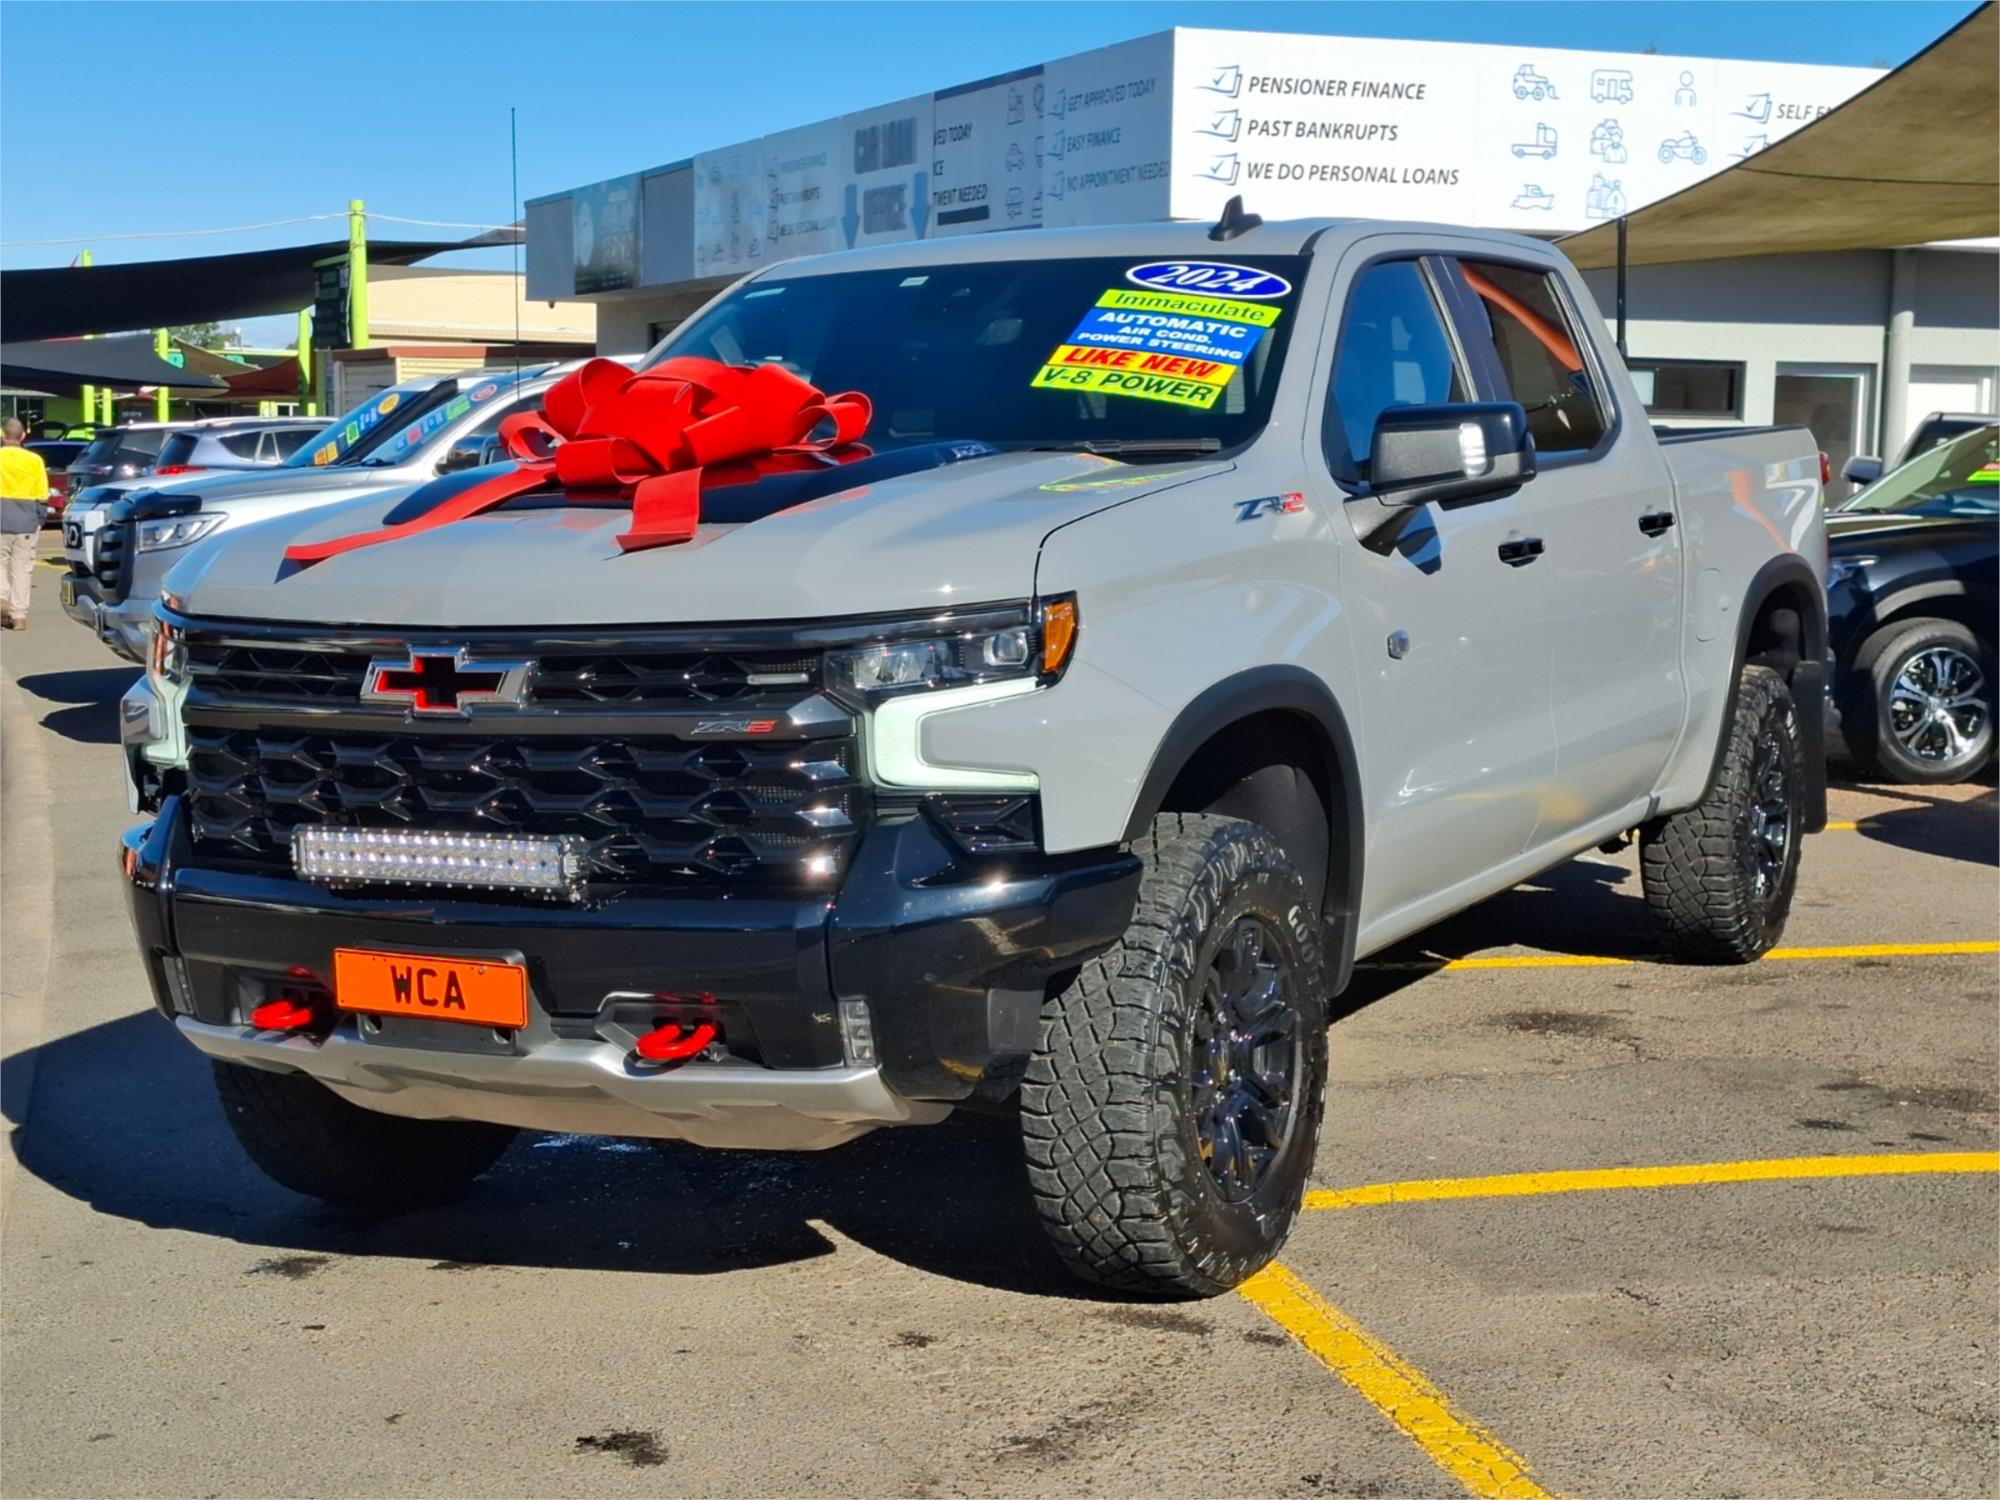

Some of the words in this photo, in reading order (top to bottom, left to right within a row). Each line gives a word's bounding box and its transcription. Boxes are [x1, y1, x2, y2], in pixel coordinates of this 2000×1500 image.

[1068, 94, 1083, 112] GET
[1084, 84, 1125, 109] APPROVED
[1127, 78, 1157, 98] TODAY
[1248, 76, 1347, 97] PENSIONER
[1351, 81, 1426, 100] FINANCE
[1776, 104, 1813, 120] SELF
[948, 123, 972, 143] TODAY
[1067, 134, 1086, 153] EASY
[1086, 127, 1121, 149] FINANCE
[1247, 119, 1292, 138] PAST
[1295, 121, 1399, 141] BANKRUPTS
[1067, 175, 1079, 192] NO
[1079, 166, 1136, 190] APPOINTMENT
[1138, 160, 1170, 181] NEEDED
[1247, 162, 1273, 180] WE
[1277, 163, 1304, 181] DO
[1308, 165, 1397, 184] PERSONAL
[1402, 167, 1460, 185] LOANS
[958, 183, 988, 203] NEEDED
[1146, 265, 1273, 292] 2024
[1115, 293, 1265, 321] Immaculate
[1097, 311, 1248, 338] AUTOMATIC
[1119, 326, 1152, 337] AIR
[1155, 329, 1213, 344] COND.
[1078, 332, 1146, 346] POWER
[1148, 338, 1243, 359] STEERING
[1063, 347, 1138, 368] LIKE
[1140, 356, 1221, 378] NEW
[1042, 367, 1091, 384] V-8
[1100, 373, 1214, 402] POWER
[390, 964, 466, 1010] WCA
